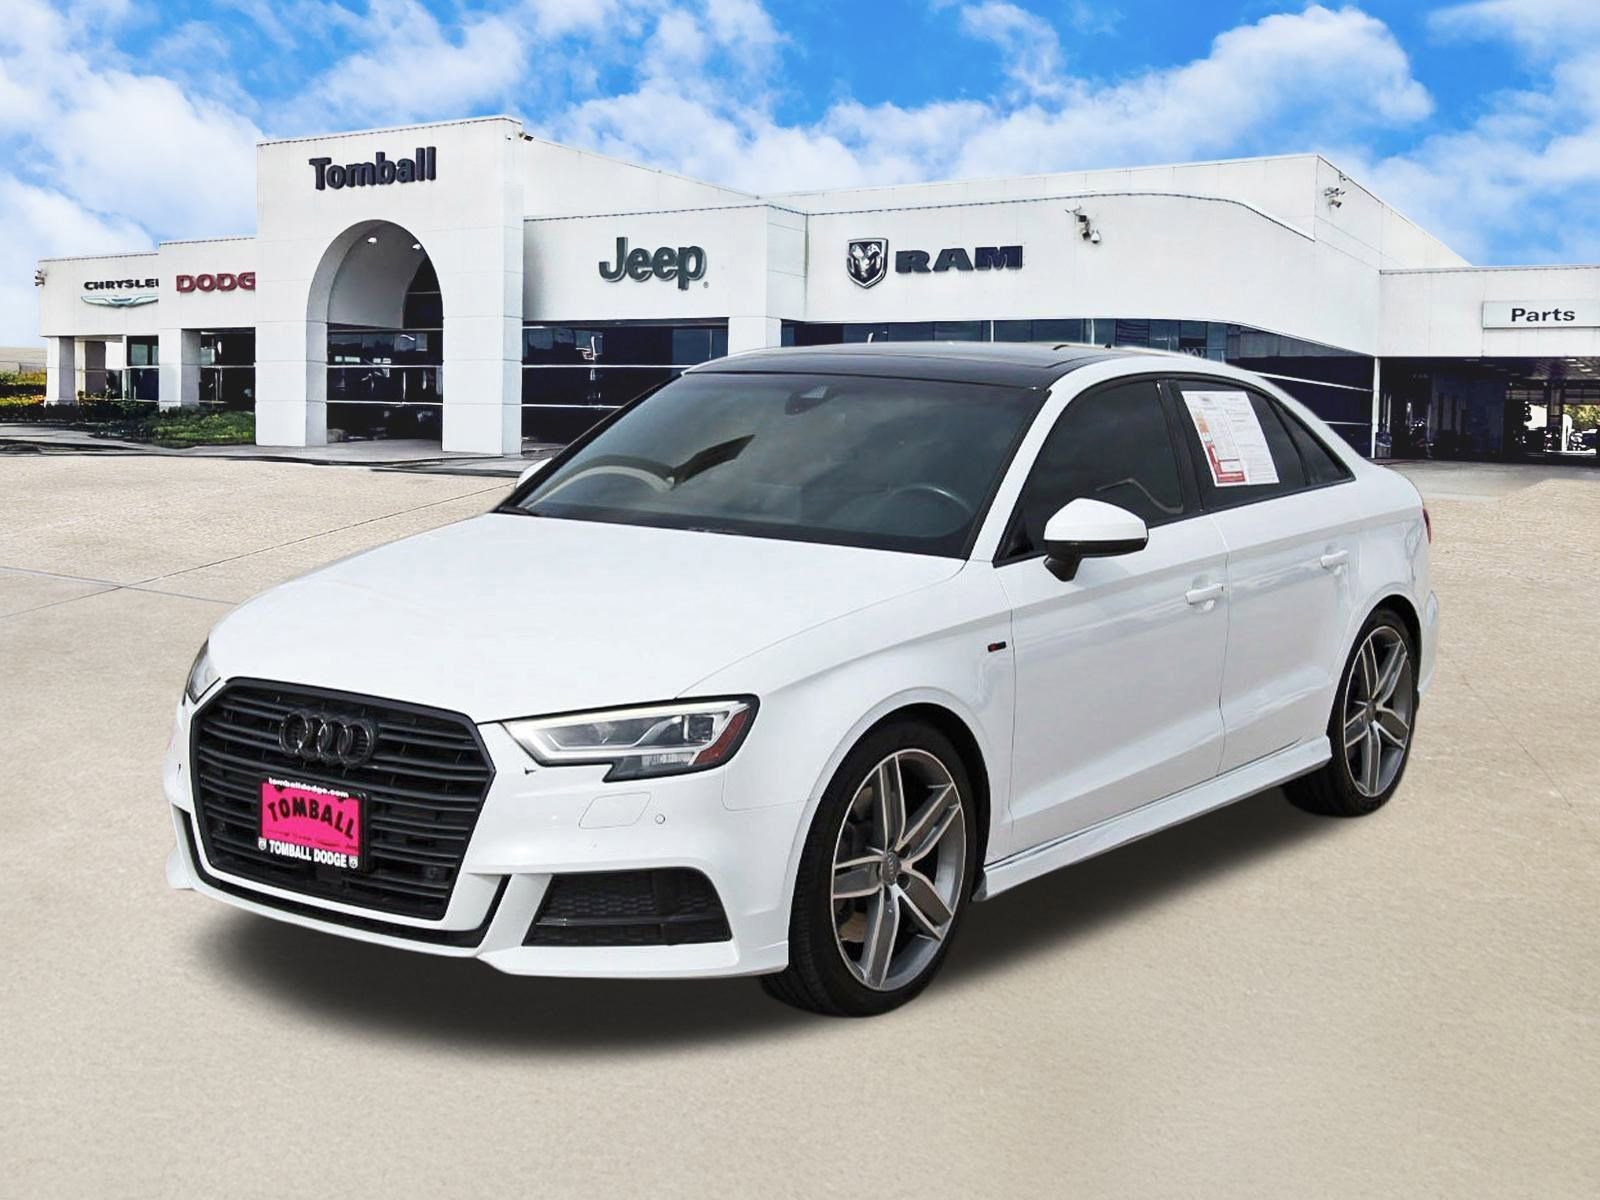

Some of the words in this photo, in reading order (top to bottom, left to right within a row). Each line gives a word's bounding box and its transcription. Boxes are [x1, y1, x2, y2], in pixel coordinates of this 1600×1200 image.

[308, 146, 437, 191] Tomball
[598, 236, 708, 291] Jeep
[895, 245, 1023, 274] RAM
[83, 278, 159, 291] CHRYSLE
[176, 271, 256, 294] DODG
[1510, 308, 1576, 322] Parts
[268, 777, 349, 799] tomballdodge.com
[267, 796, 355, 840] TOMBALL
[269, 839, 312, 861] TOMBALL
[313, 847, 348, 868] DODGE
